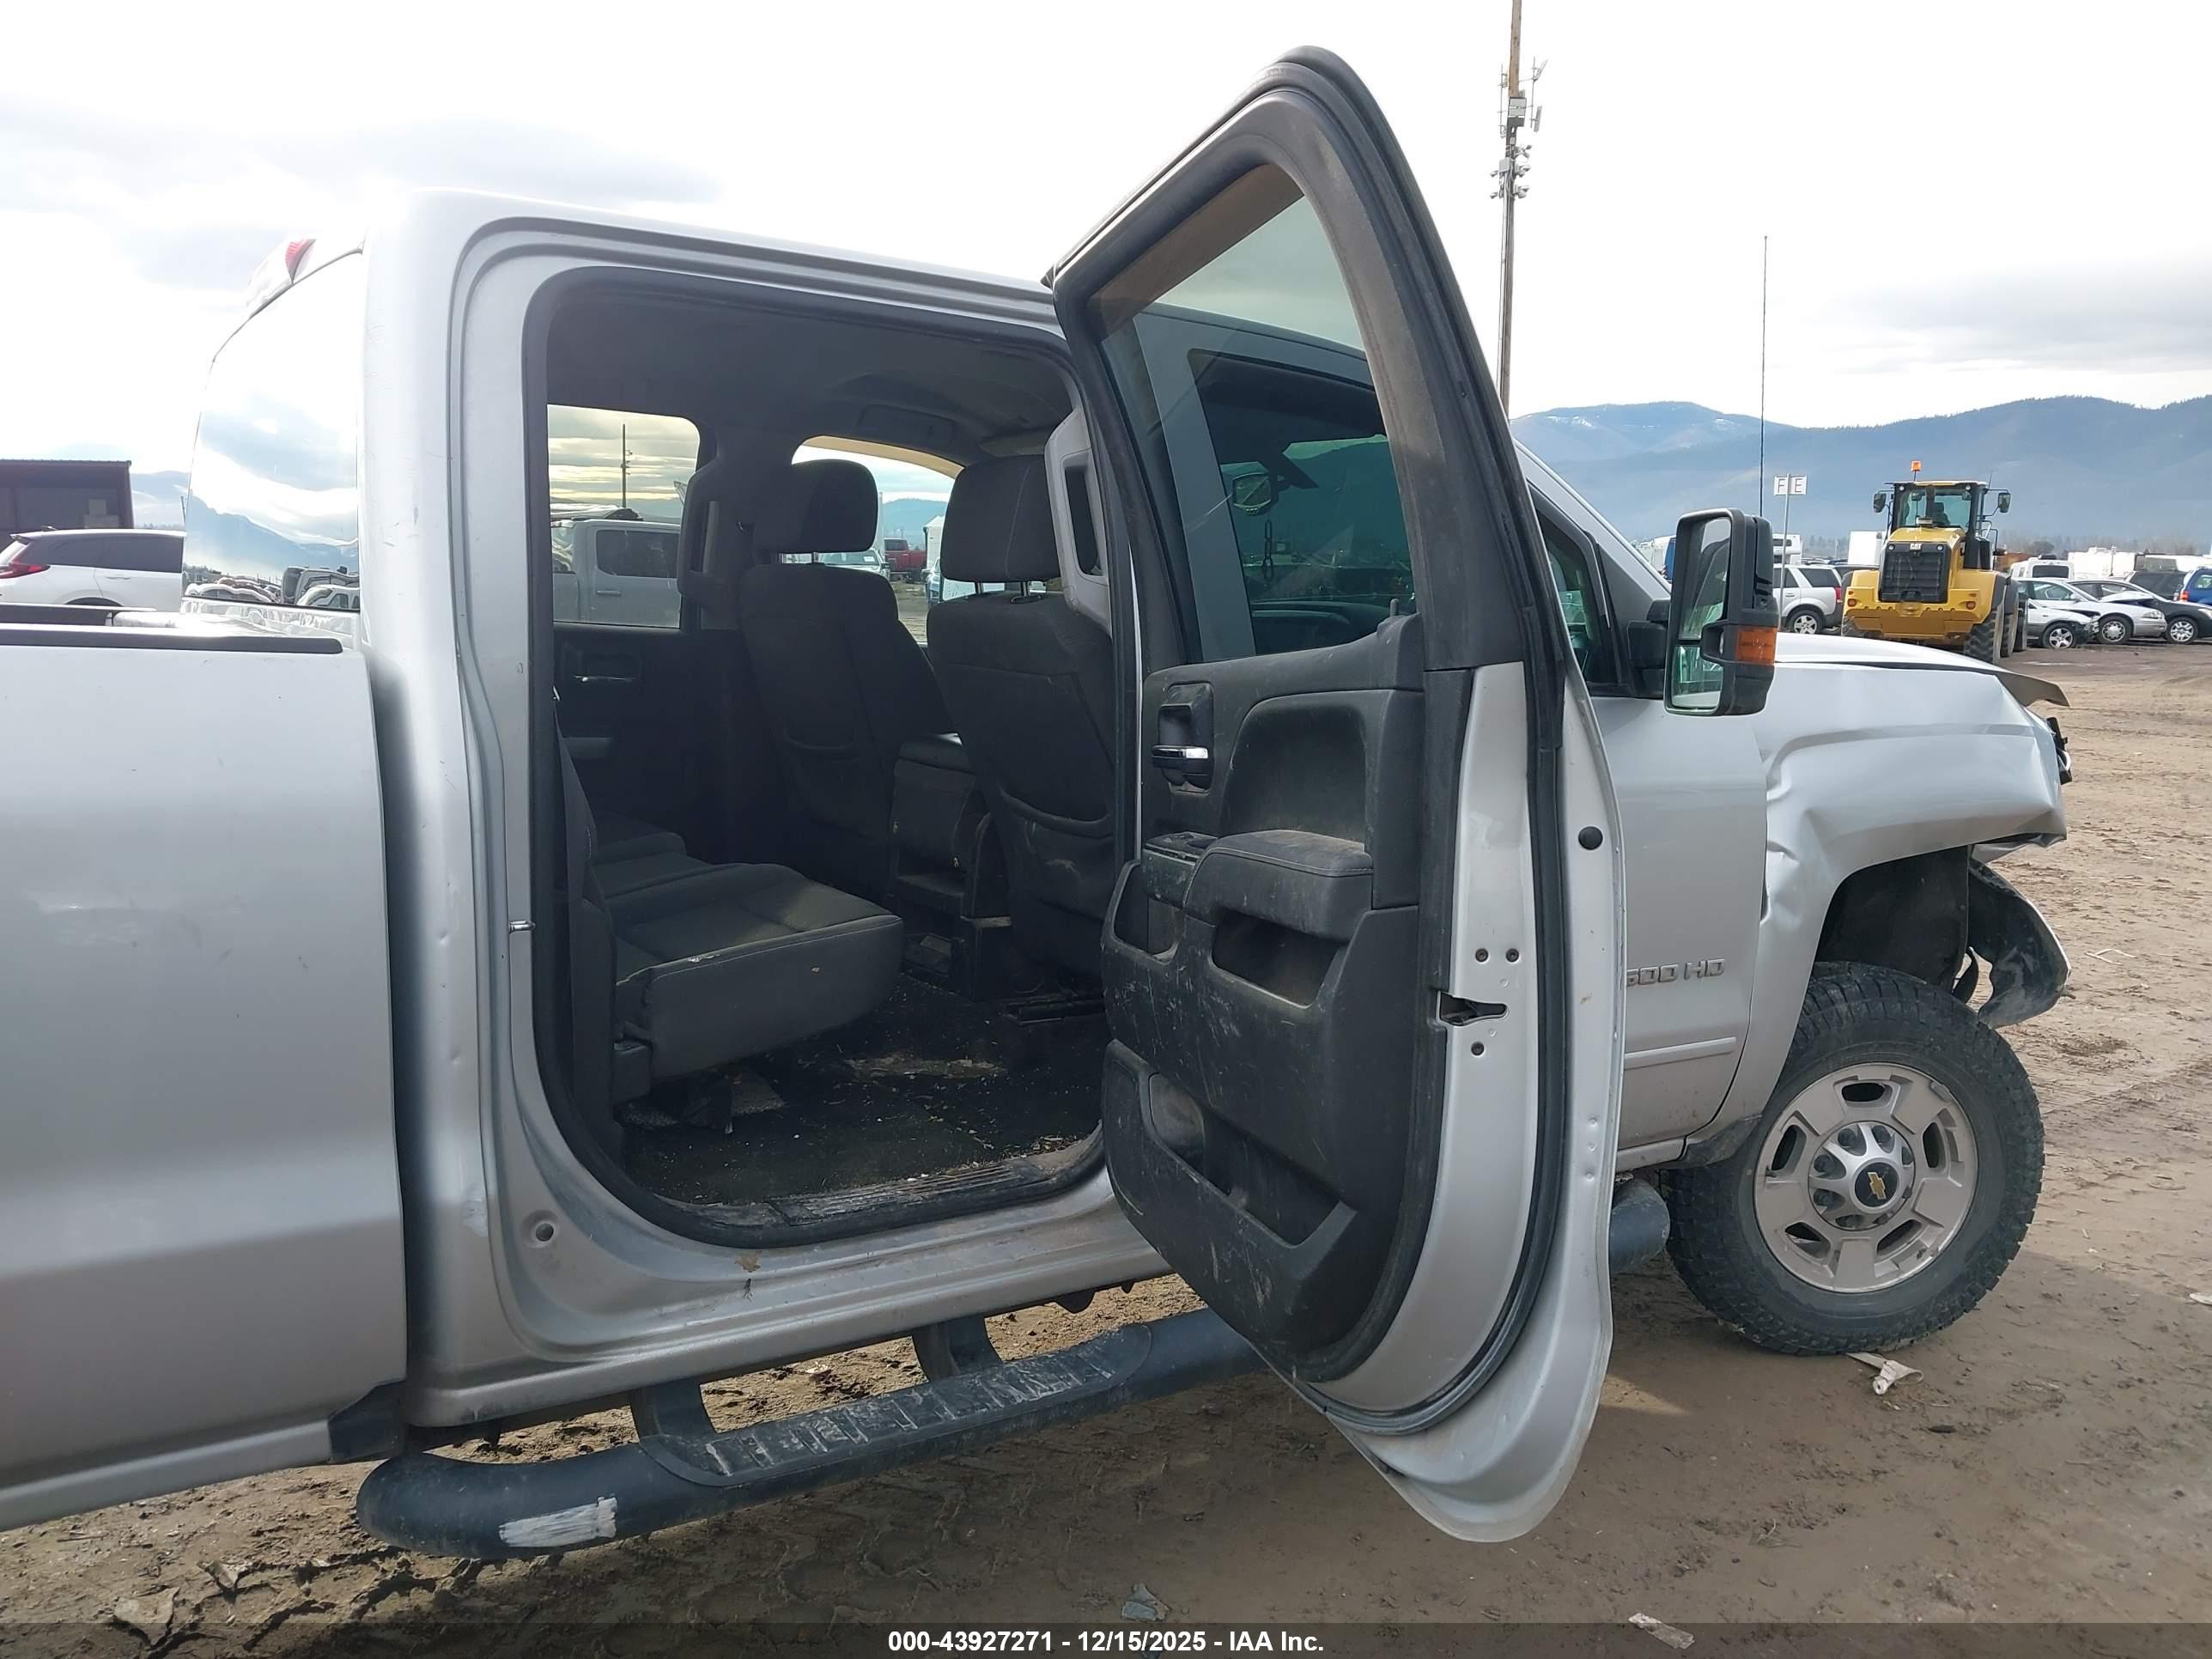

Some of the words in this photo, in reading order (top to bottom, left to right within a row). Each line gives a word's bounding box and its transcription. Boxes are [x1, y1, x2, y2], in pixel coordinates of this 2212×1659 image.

[1778, 478, 1786, 494] F
[1794, 477, 1803, 494] E
[1684, 958, 1725, 981] HD
